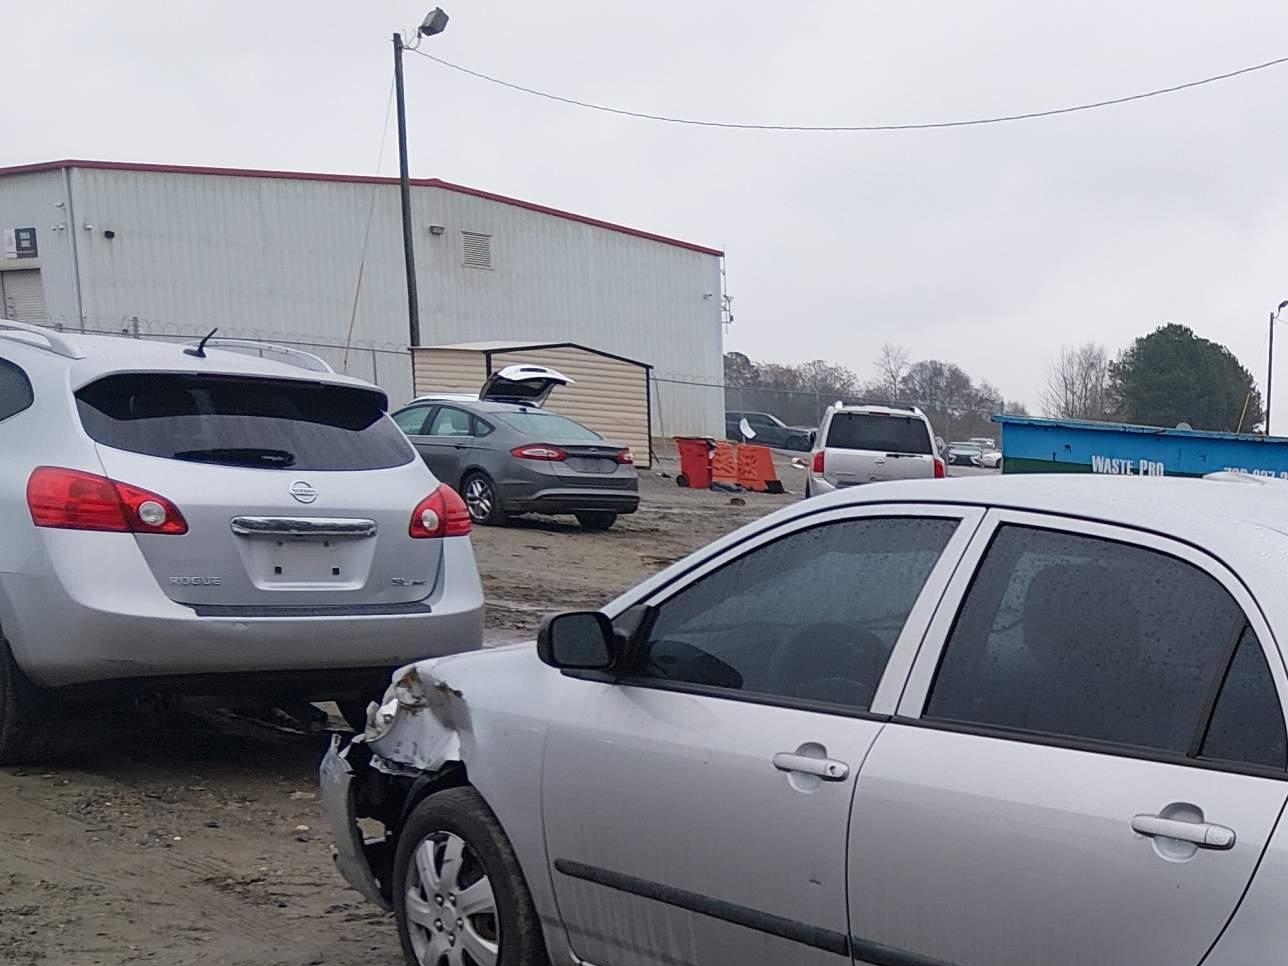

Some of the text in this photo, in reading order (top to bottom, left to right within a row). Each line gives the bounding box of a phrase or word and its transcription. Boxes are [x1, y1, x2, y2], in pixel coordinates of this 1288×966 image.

[1091, 455, 1165, 477] WASTE PRO
[168, 576, 222, 586] ROGUE
